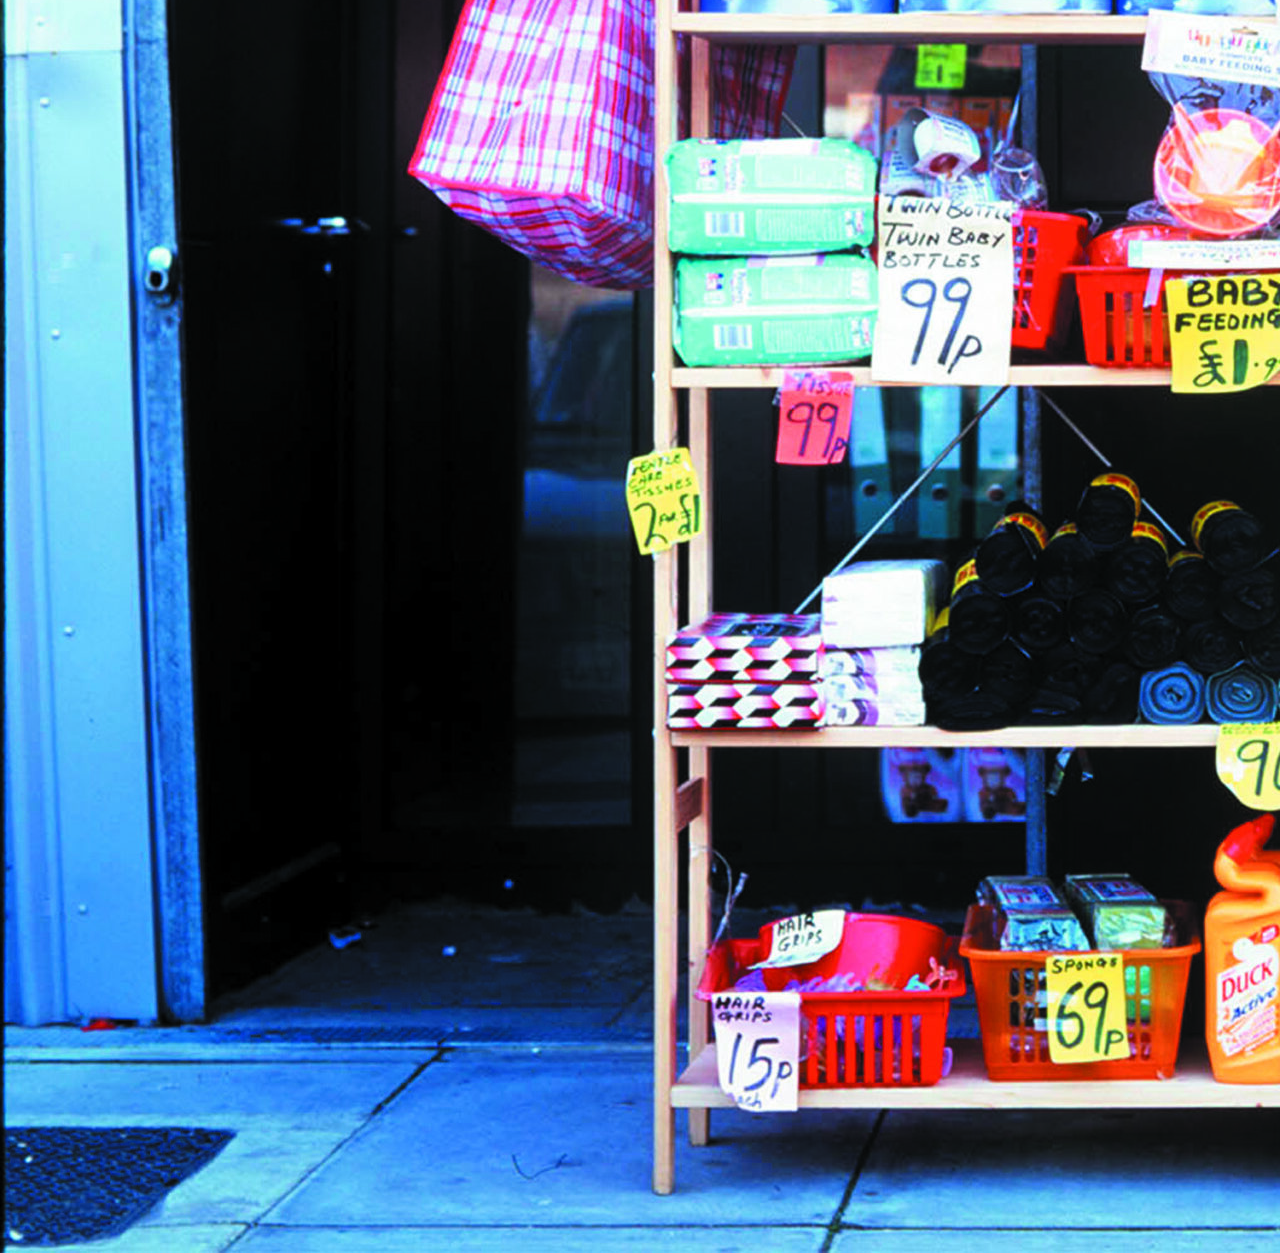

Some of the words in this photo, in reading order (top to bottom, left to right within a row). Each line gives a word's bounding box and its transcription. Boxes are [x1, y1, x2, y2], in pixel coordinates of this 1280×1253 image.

[1182, 54, 1216, 65] BABY
[1219, 56, 1273, 74] FEEDING
[884, 193, 942, 215] TWIN
[881, 221, 941, 247] TWIN
[947, 225, 1006, 248] BABY
[883, 250, 982, 270] BOTTLES
[901, 276, 983, 375] 99p
[787, 402, 848, 464] 99p
[633, 501, 668, 547] 2
[678, 493, 700, 535] £1
[777, 912, 816, 937] HAIR
[777, 929, 823, 953] GRIPS
[1221, 957, 1273, 1003] DUCK
[715, 997, 766, 1010] HAIR
[717, 1011, 773, 1023] GRIPS
[1056, 981, 1125, 1057] 69p
[728, 1033, 793, 1098] 15p
